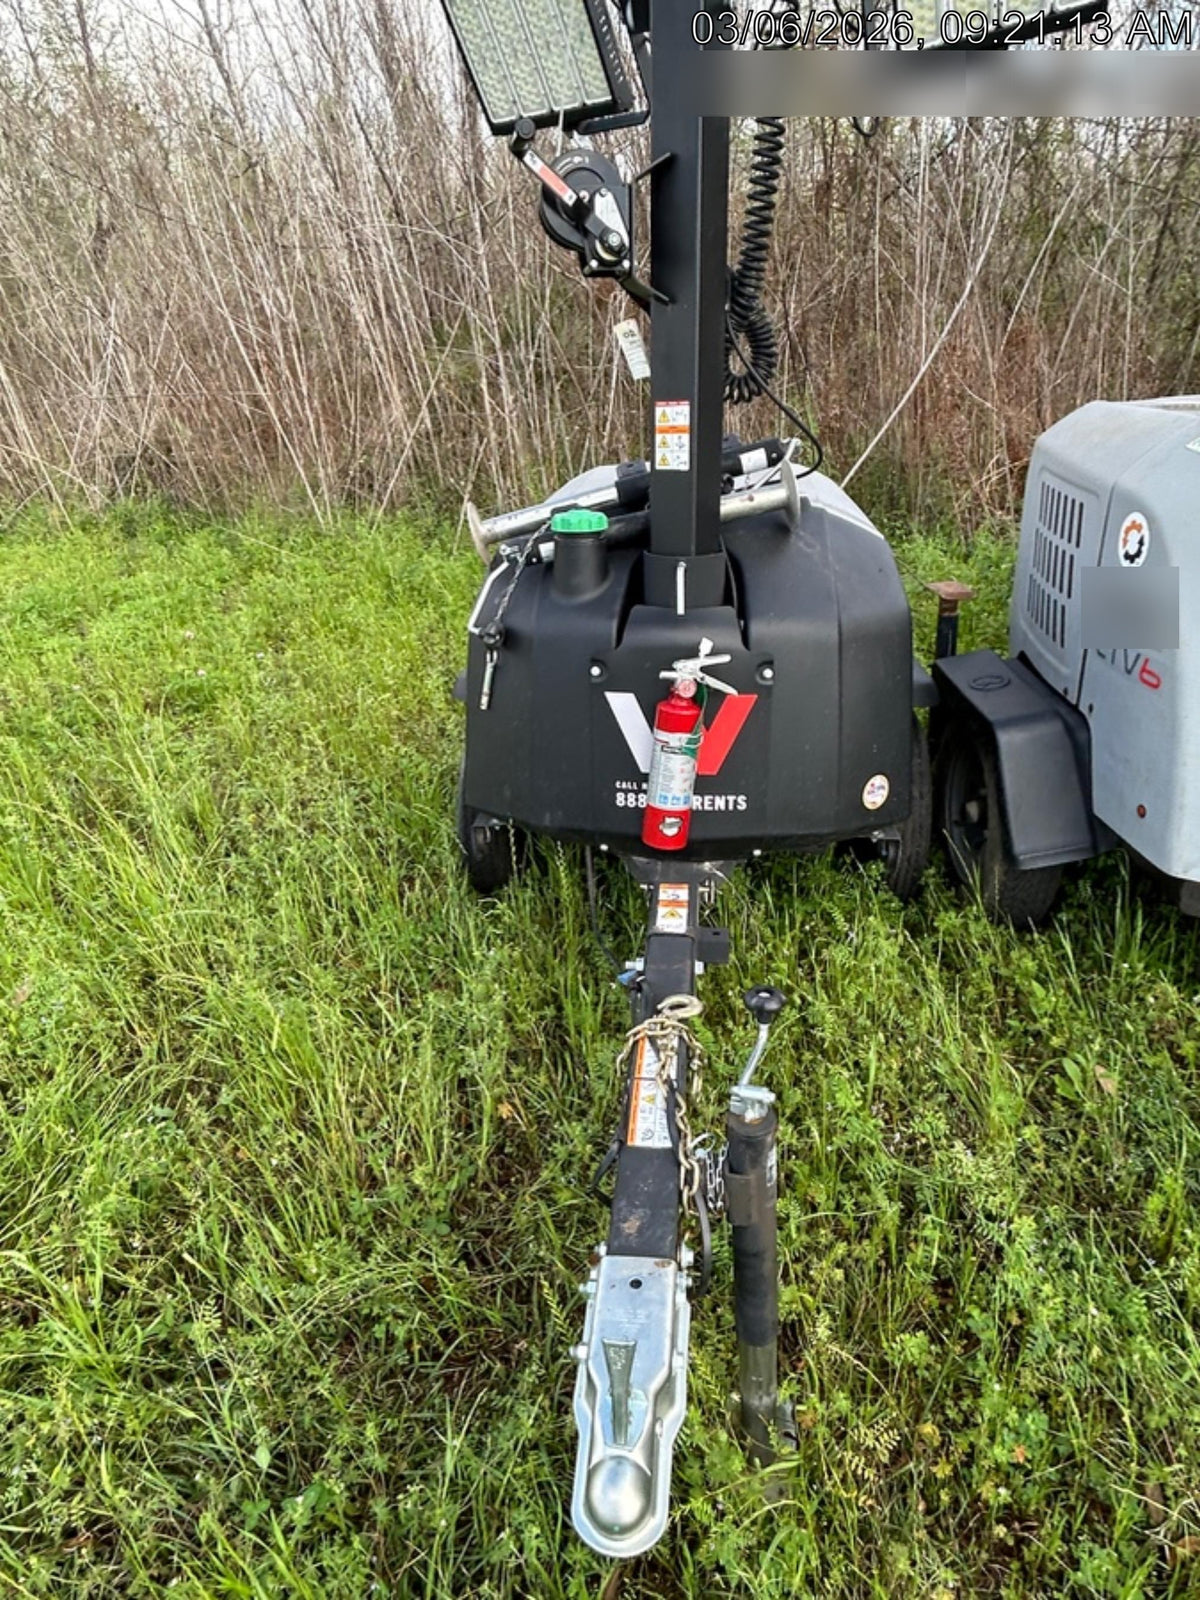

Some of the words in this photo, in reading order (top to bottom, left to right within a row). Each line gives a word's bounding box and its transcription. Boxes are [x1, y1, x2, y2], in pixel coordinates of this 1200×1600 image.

[615, 780, 638, 790] CALL
[615, 791, 647, 808] 888
[692, 795, 747, 811] RENTS
